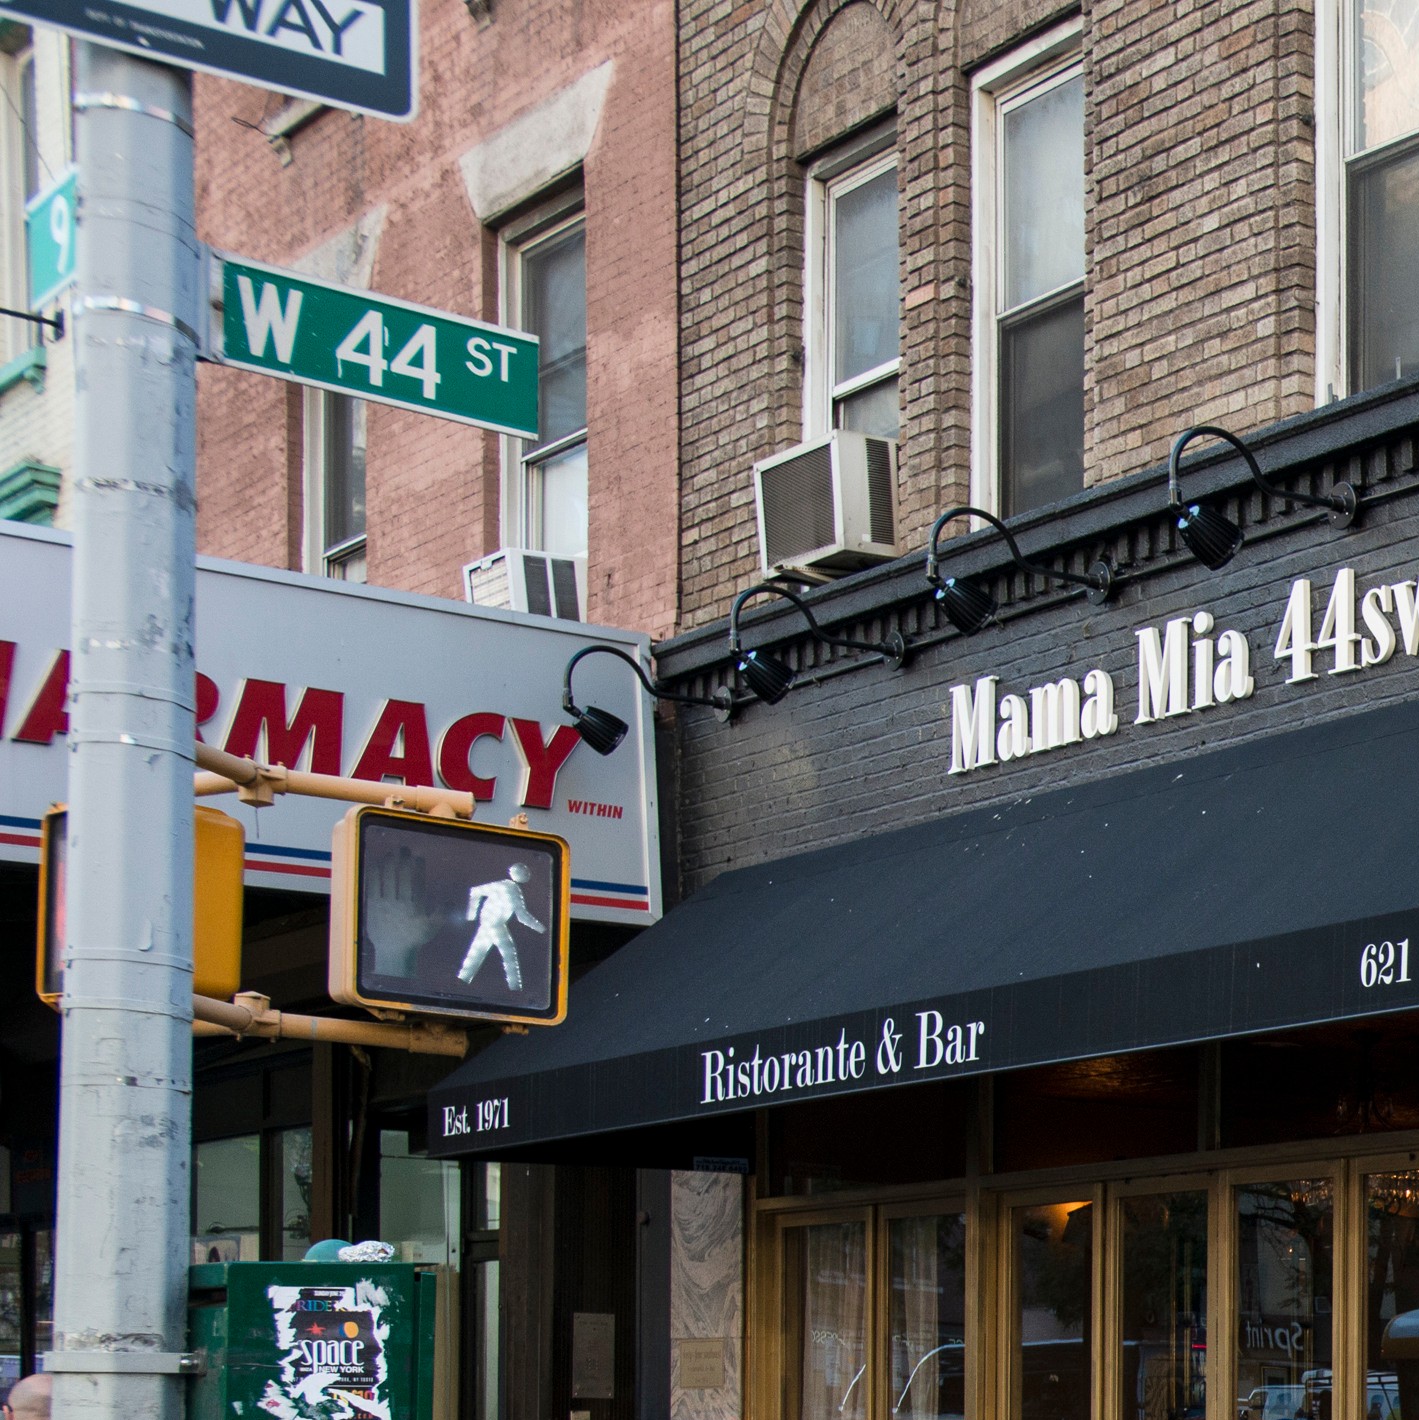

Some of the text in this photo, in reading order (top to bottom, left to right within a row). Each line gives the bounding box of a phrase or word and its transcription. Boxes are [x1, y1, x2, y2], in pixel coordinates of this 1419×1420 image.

[209, 0, 365, 56] WAY
[49, 194, 70, 276] 9
[237, 274, 518, 400] W 44 ST
[948, 675, 1119, 776] Mama
[1134, 611, 1254, 725] Mia
[0, 640, 582, 810] AMACY
[568, 800, 624, 819] WITHIN
[1360, 937, 1412, 989] 621
[701, 1010, 985, 1104] Ristorante & Bar
[442, 1097, 511, 1137] Est. 1971
[300, 1339, 365, 1374] space
[340, 1366, 364, 1374] YORK
